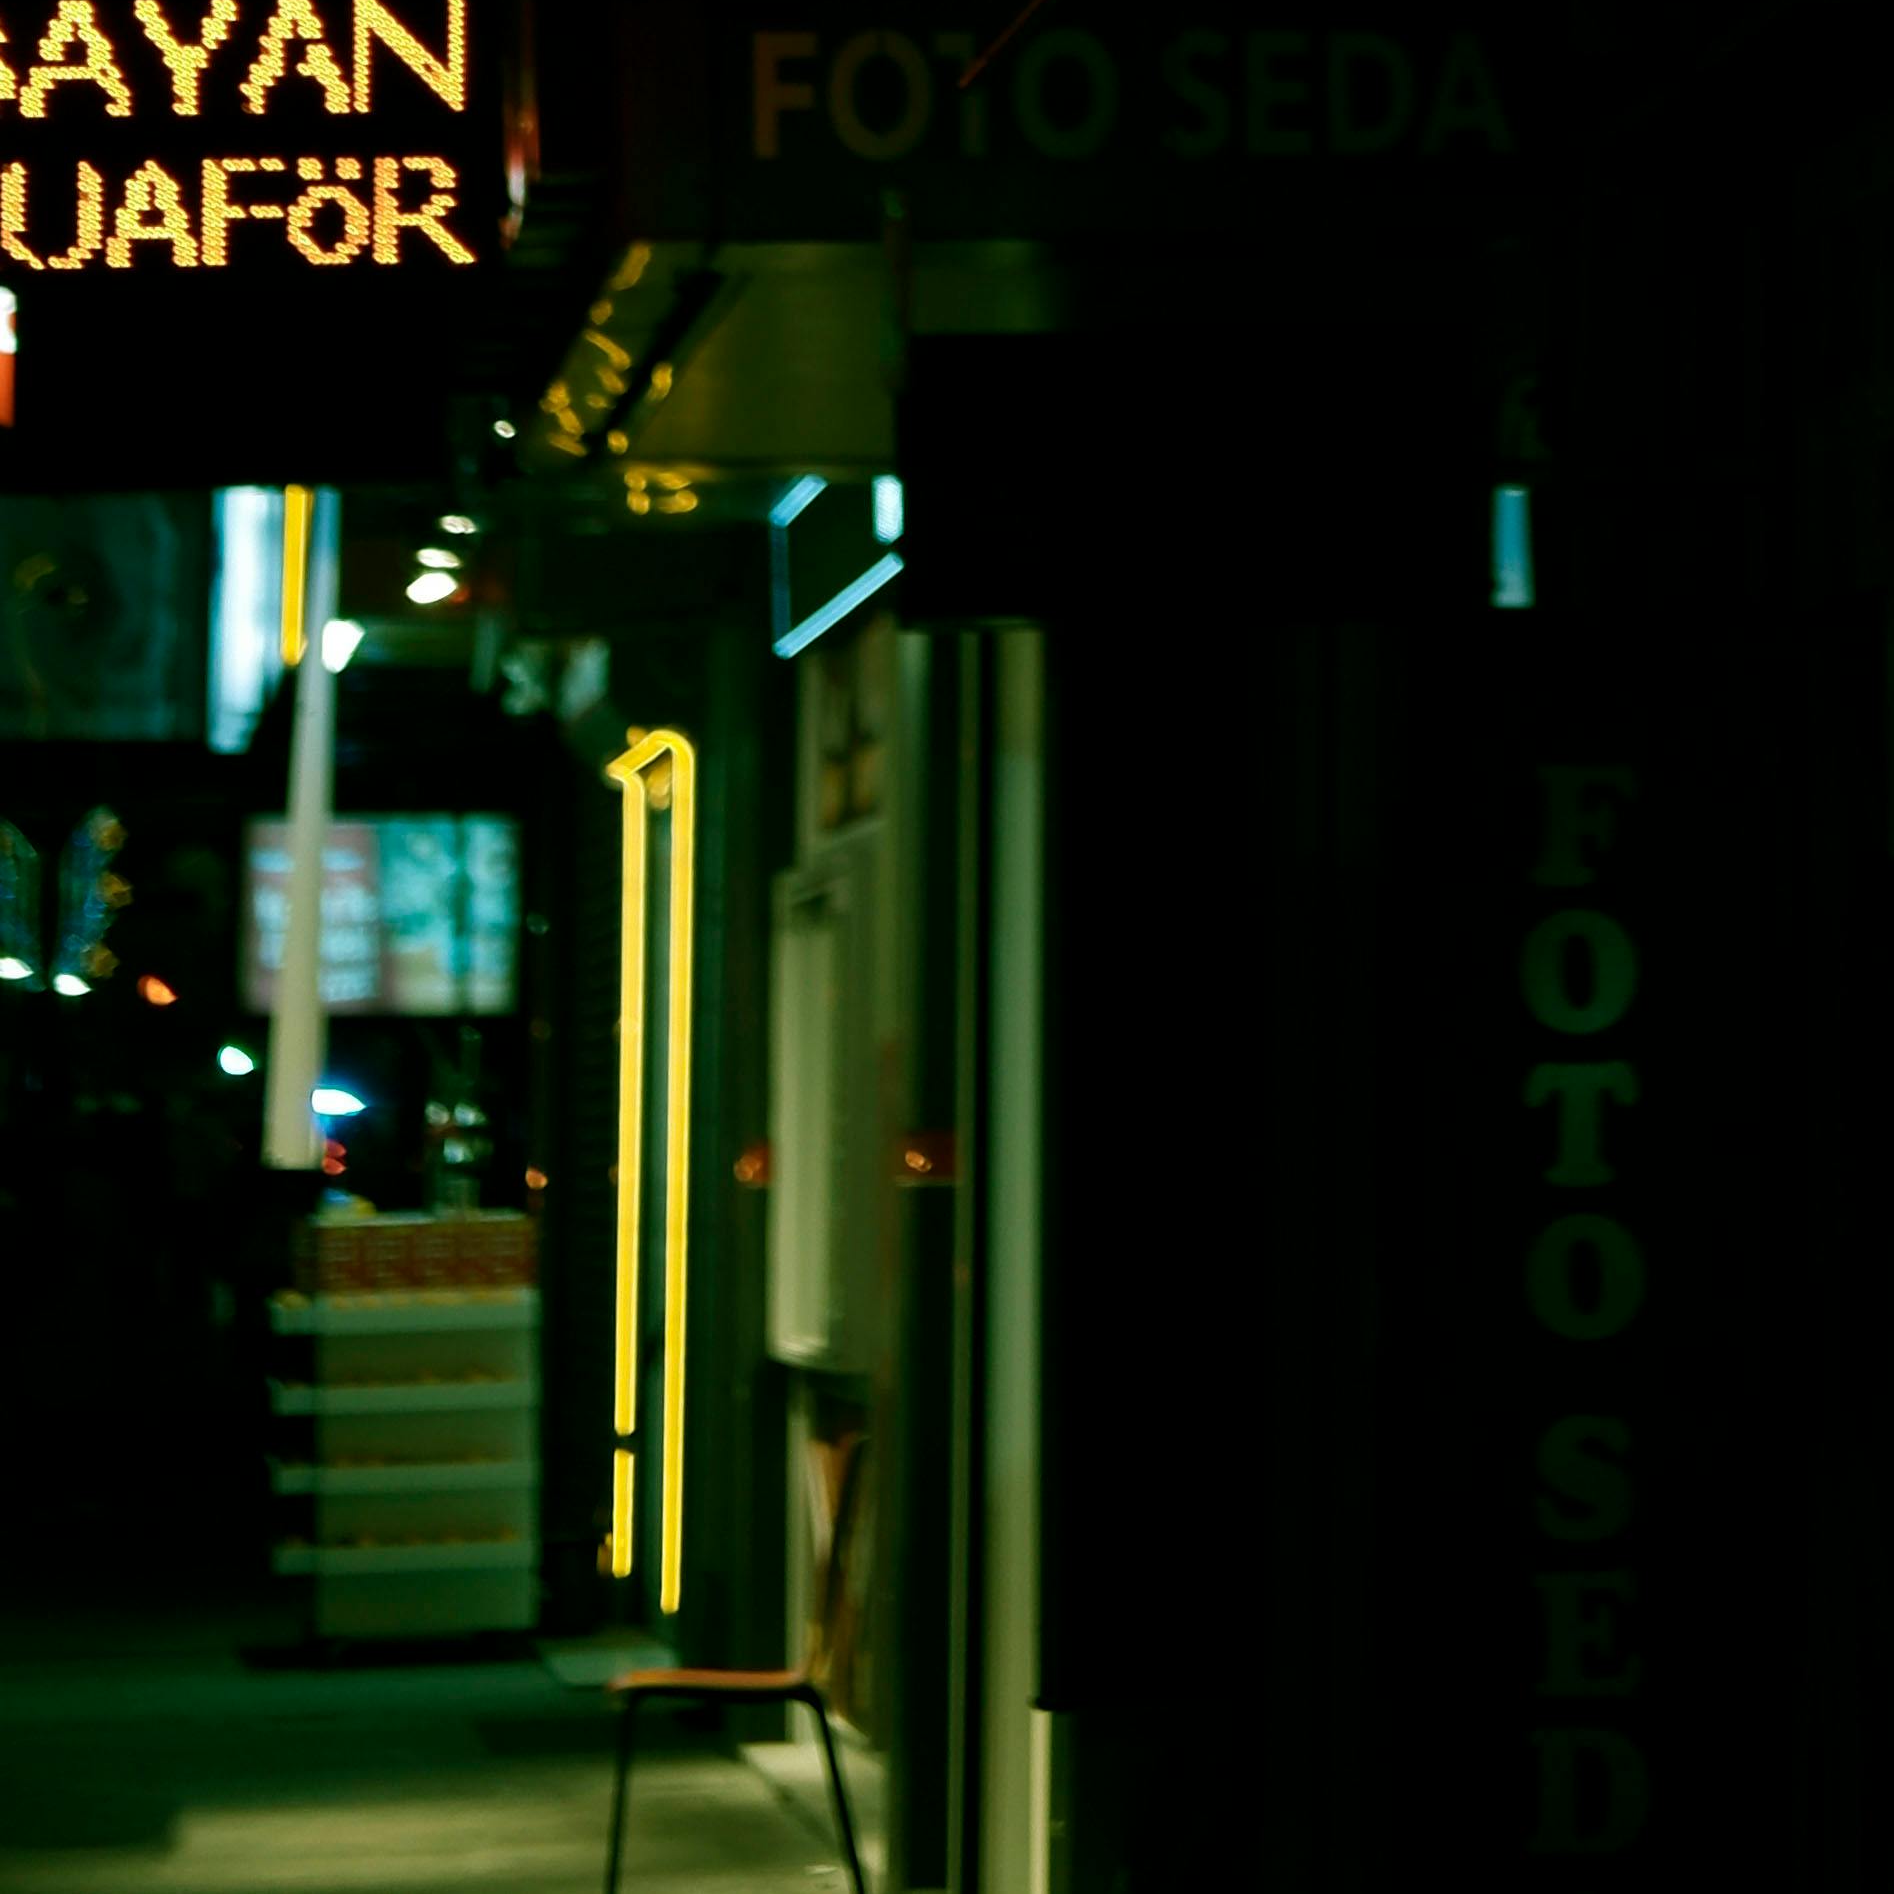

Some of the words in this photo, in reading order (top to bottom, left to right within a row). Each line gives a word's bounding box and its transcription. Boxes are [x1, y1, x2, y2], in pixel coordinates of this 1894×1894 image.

[748, 26, 1122, 163] FOTO
[1158, 24, 1522, 163] SEDA
[1516, 763, 1646, 1341] FOTO
[1518, 1413, 1654, 1859] SED
